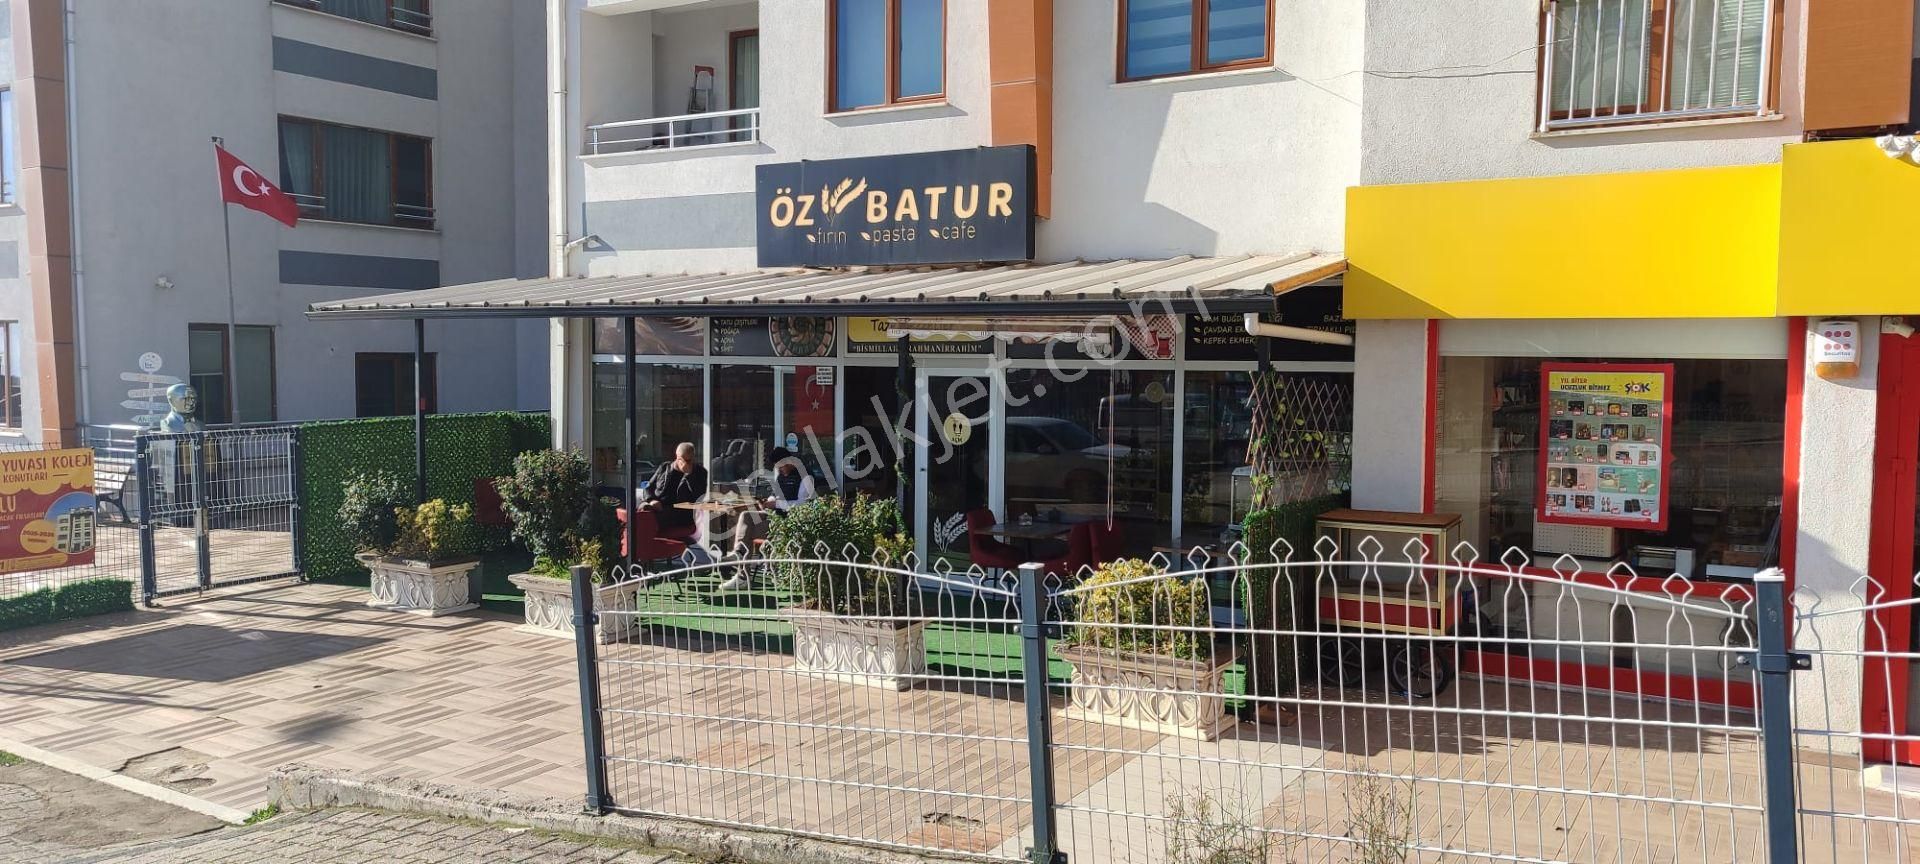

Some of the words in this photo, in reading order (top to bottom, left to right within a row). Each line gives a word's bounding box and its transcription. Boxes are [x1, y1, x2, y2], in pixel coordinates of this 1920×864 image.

[770, 187, 815, 228] ÖZ
[866, 182, 1013, 224] BATUR
[873, 224, 916, 244] pasta
[941, 220, 977, 240] cafe
[1203, 337, 1227, 345] KEPEK
[2, 457, 47, 472] YUVASI
[52, 452, 92, 469] KOLEJİ
[3, 471, 48, 483] KONUTLARI
